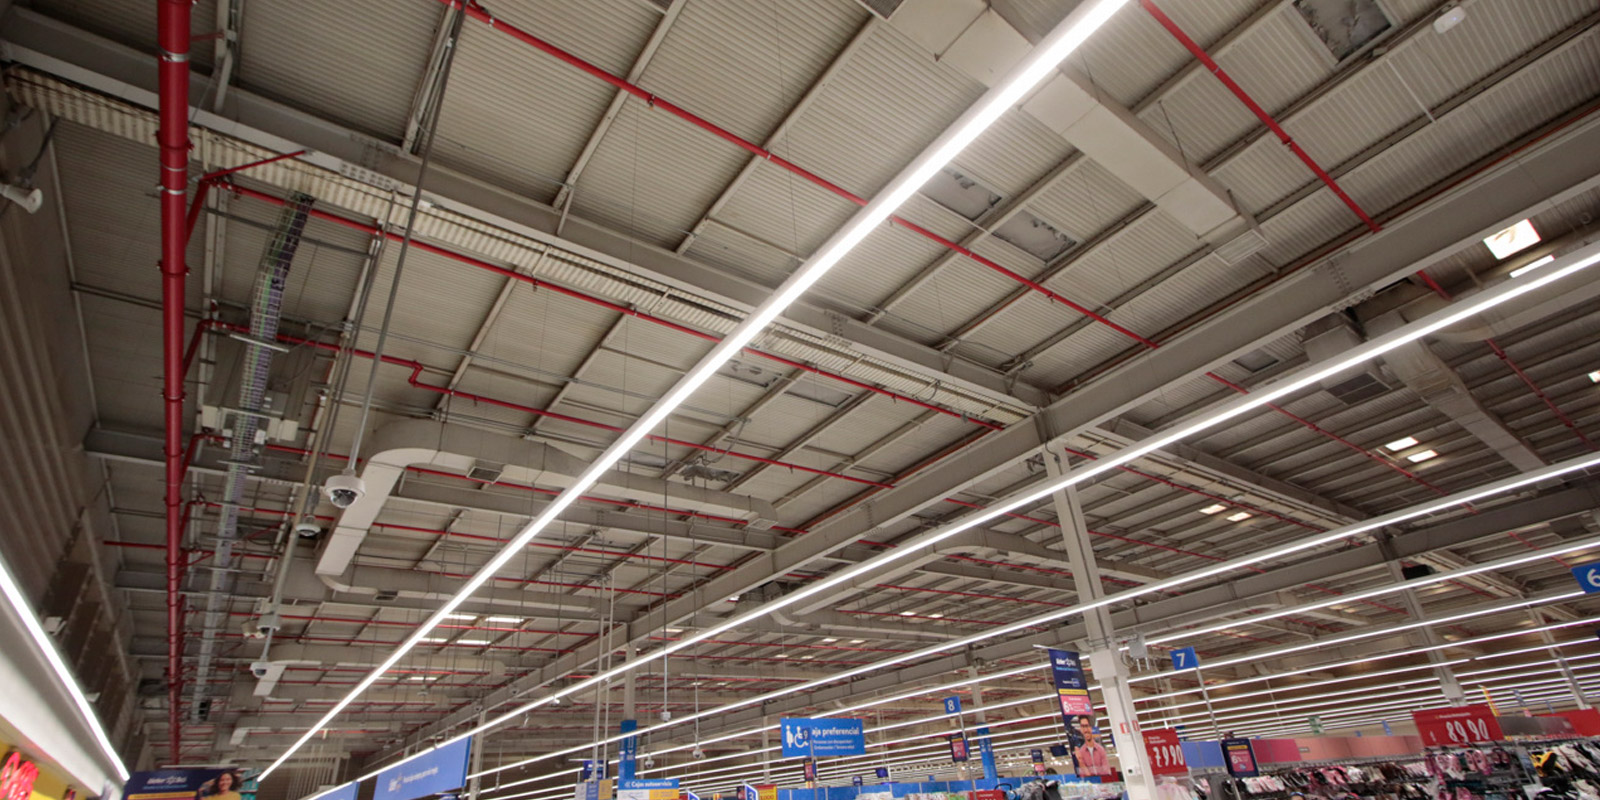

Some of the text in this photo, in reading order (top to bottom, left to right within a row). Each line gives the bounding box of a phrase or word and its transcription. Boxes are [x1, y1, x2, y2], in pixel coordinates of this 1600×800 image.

[1587, 568, 1600, 587] 6
[1176, 652, 1185, 667] 7
[947, 699, 955, 711] 8
[812, 727, 860, 738] aja preferencial
